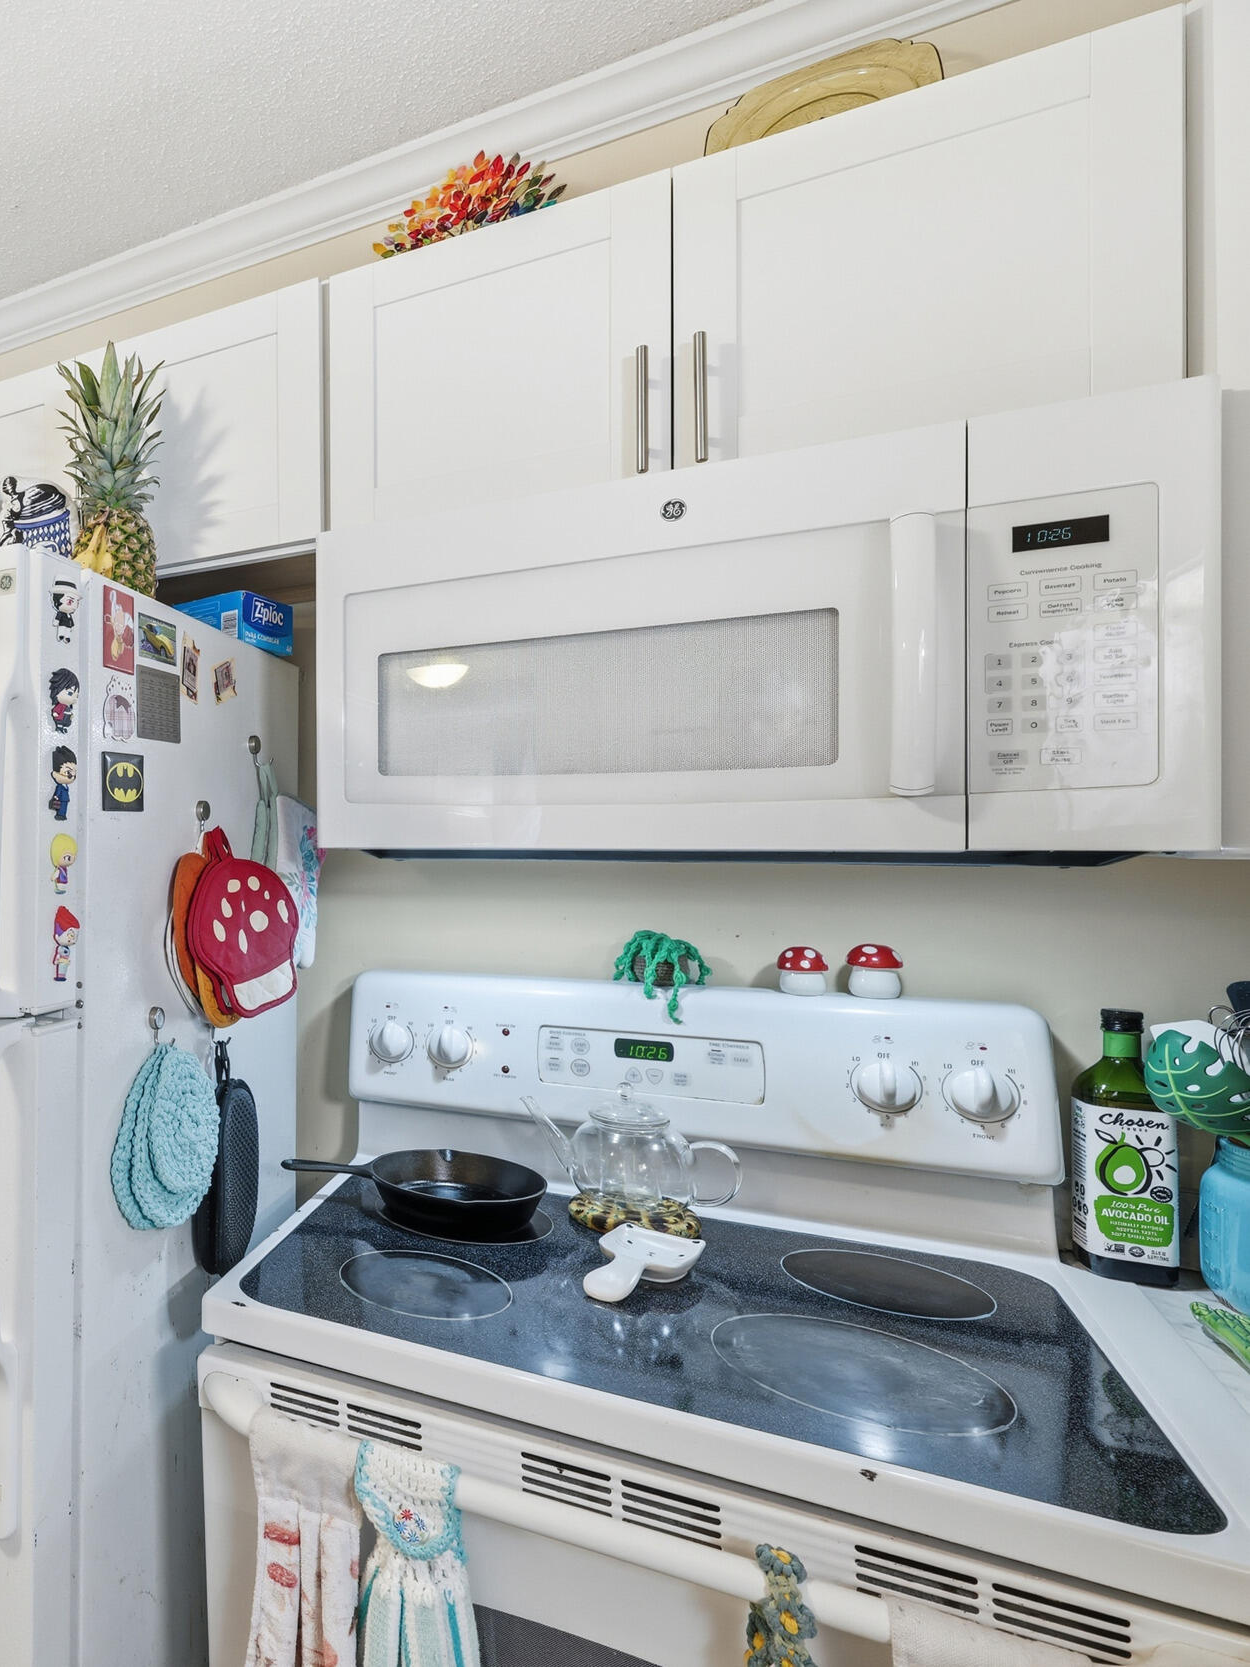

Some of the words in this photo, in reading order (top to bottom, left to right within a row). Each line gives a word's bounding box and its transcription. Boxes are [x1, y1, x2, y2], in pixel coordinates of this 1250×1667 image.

[1026, 527, 1072, 543] 10:26
[1104, 576, 1127, 584] Potato
[994, 588, 1021, 596] Popcorn
[255, 599, 284, 626] Ziploc
[629, 1046, 668, 1060] 10:26
[877, 1052, 890, 1060] OFF
[1099, 1112, 1169, 1131] Chosen
[1102, 1209, 1151, 1222] AVOCADO
[1154, 1216, 1170, 1226] OIL
